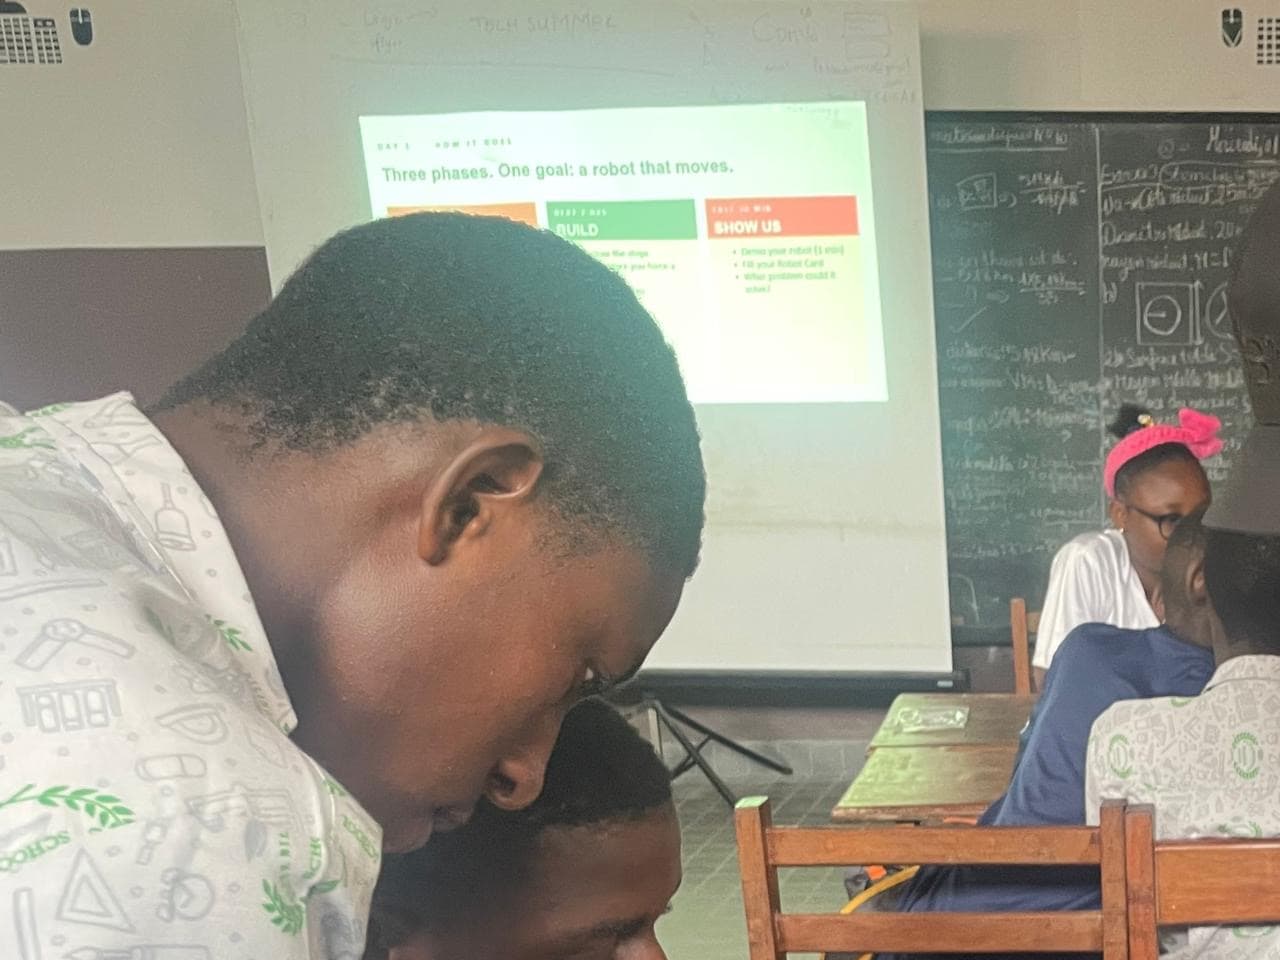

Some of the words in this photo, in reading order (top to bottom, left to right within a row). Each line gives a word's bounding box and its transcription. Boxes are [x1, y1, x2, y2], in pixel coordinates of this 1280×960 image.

[381, 166, 427, 182] Three
[431, 166, 494, 184] phases.
[498, 163, 530, 178] One
[535, 163, 574, 181] goal:
[579, 165, 589, 177] a
[592, 161, 636, 177] robot
[640, 160, 672, 176] that
[675, 159, 735, 175] moves.
[556, 223, 600, 238] BUILD
[713, 219, 759, 235] SHOW
[761, 218, 783, 233] US
[767, 247, 787, 257] your
[789, 246, 812, 255] robot
[756, 261, 775, 270] your
